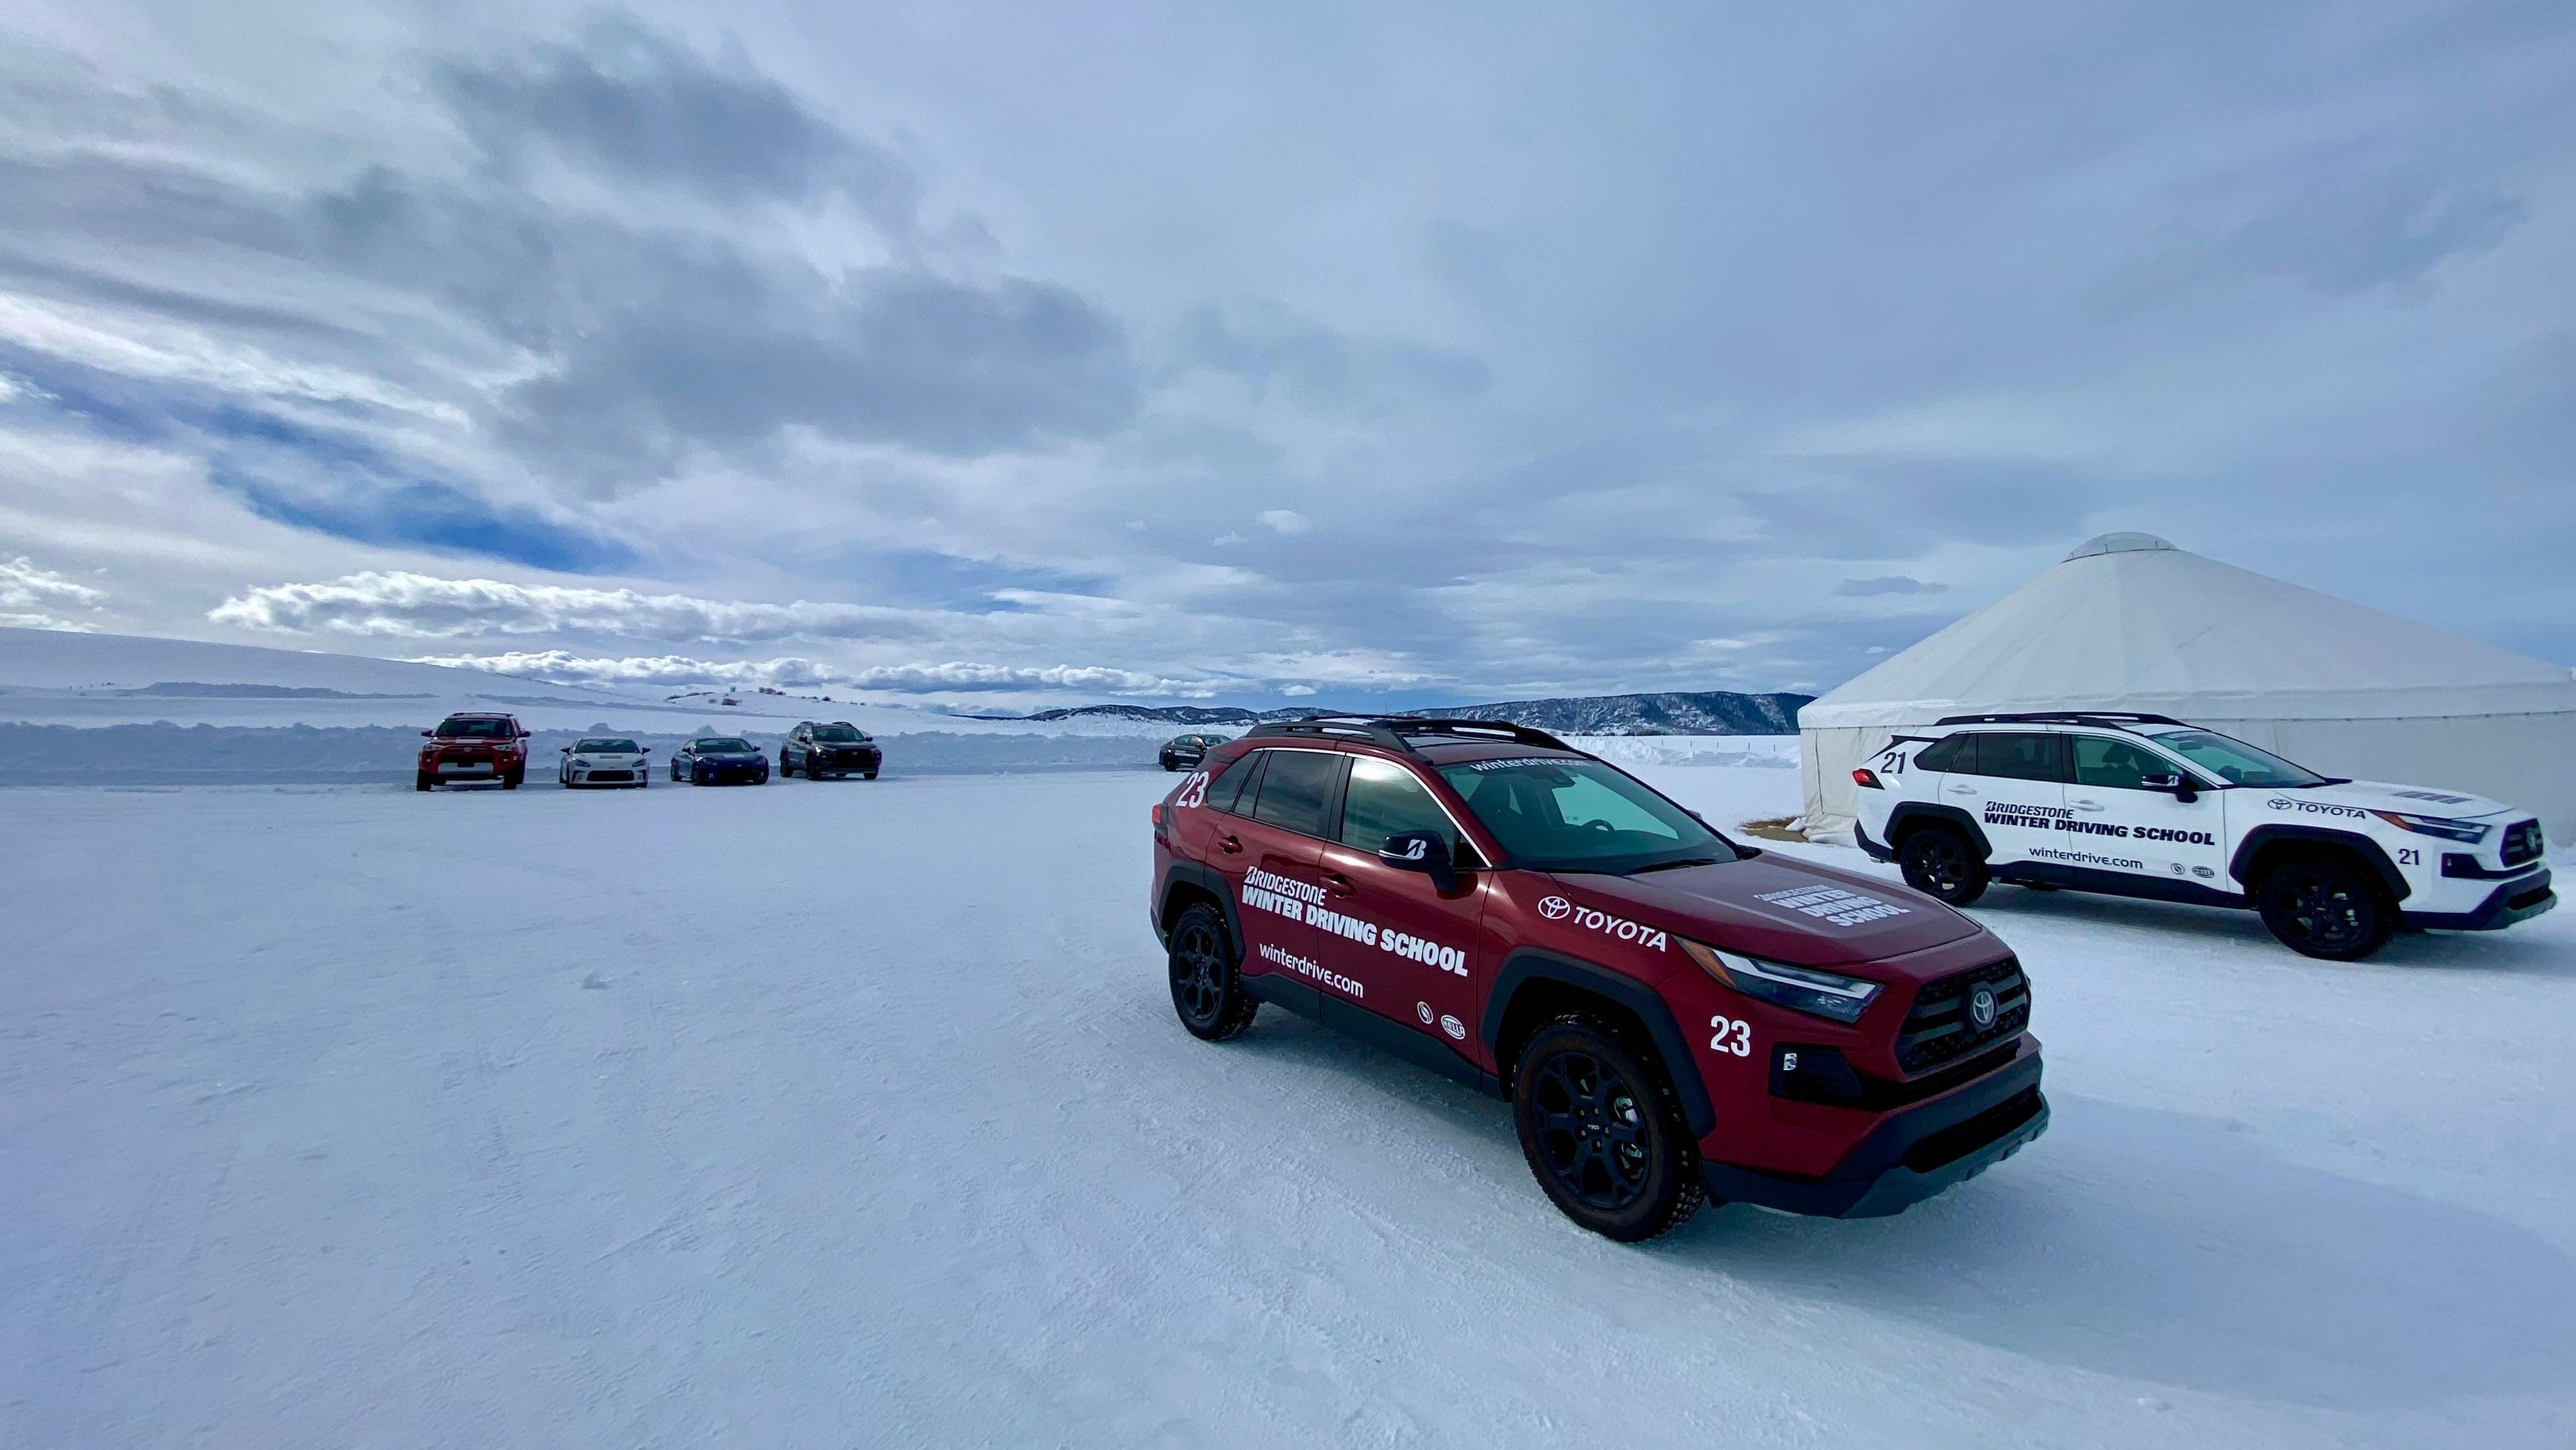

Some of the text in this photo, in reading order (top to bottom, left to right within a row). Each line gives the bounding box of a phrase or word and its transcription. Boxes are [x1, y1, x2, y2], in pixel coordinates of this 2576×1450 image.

[1880, 751, 1906, 774] 21
[1175, 771, 1209, 808] 23
[1984, 800, 2075, 820] BRIDGESTONE
[2295, 802, 2366, 820] TOYOTA
[1984, 813, 2215, 846] WINTER DRIVING SCHOOL
[2029, 846, 2143, 869] winterdrive.com
[2398, 848, 2420, 866] 21
[1244, 866, 1327, 906] BRIDGESTONE
[1770, 889, 1857, 908] WINTER
[1796, 896, 1883, 917] DRIVING
[1826, 904, 1912, 926] SCHOOL
[1242, 885, 1468, 977] WINTER DRIVING SCHOOL
[1574, 906, 1667, 952] TOYOTA
[1259, 943, 1363, 998] winterdrive.com
[1710, 1015, 1751, 1057] 23
